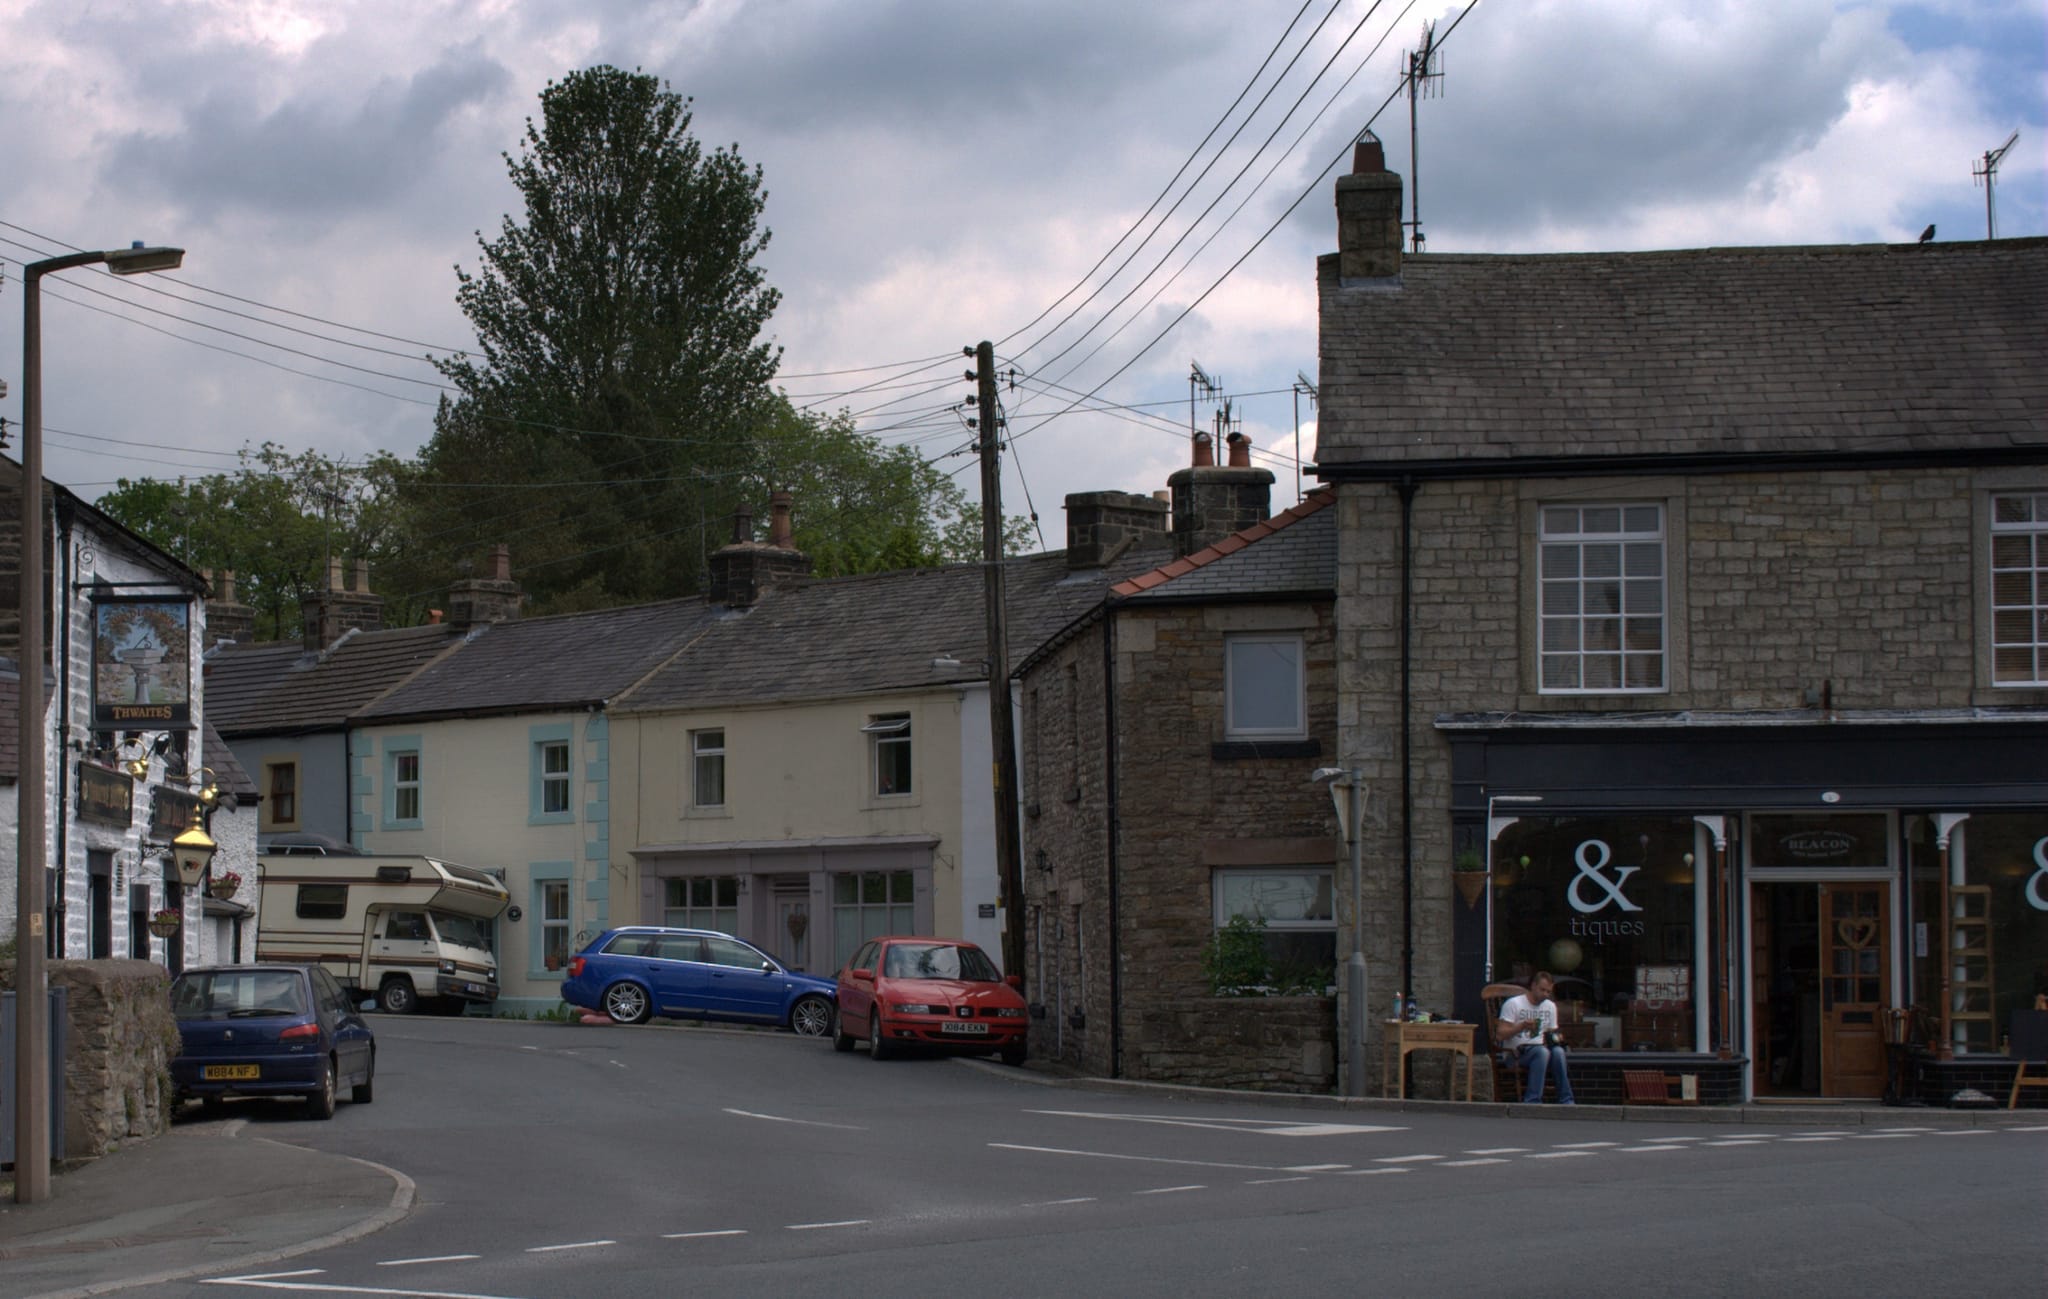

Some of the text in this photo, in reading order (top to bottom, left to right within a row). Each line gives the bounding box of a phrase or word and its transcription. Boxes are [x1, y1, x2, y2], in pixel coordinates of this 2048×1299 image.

[112, 706, 172, 720] THWAITES
[1788, 839, 1850, 849] BEACON
[1567, 839, 1643, 913] &
[1569, 915, 1645, 945] tiques
[1519, 1009, 1551, 1021] SUPER
[236, 1066, 257, 1077] NFJ
